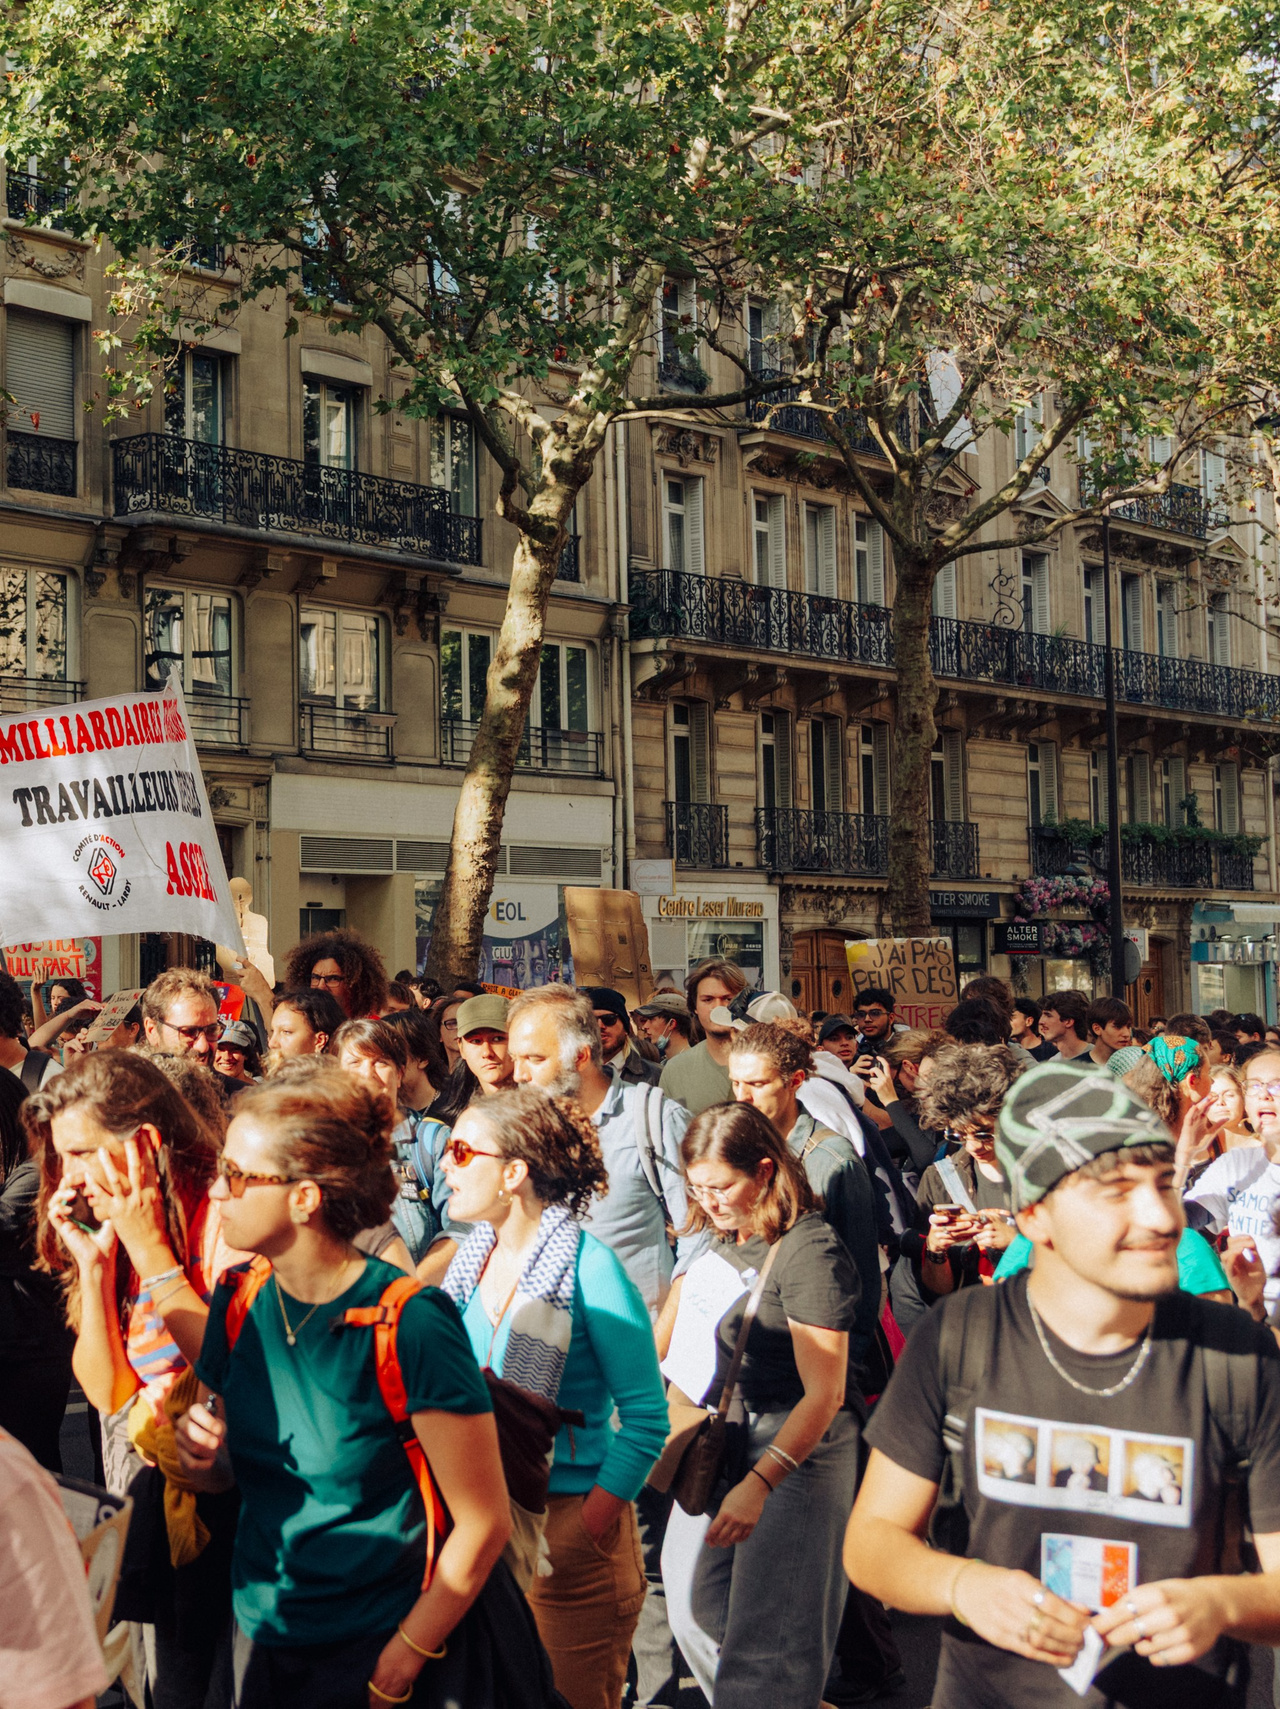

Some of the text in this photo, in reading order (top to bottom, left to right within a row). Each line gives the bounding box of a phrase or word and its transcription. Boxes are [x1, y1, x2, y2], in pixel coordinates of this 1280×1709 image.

[13, 770, 179, 827] TRAVAILLEURS
[73, 834, 93, 862] COMITÉ
[79, 885, 110, 910] RENAULT
[117, 878, 132, 907] LARDY
[659, 895, 764, 917] Centre Laser Murano
[958, 893, 991, 906] SMOKE
[911, 939, 952, 965] PAS
[43, 955, 84, 978] PART
[852, 966, 956, 997] PEUR DES
